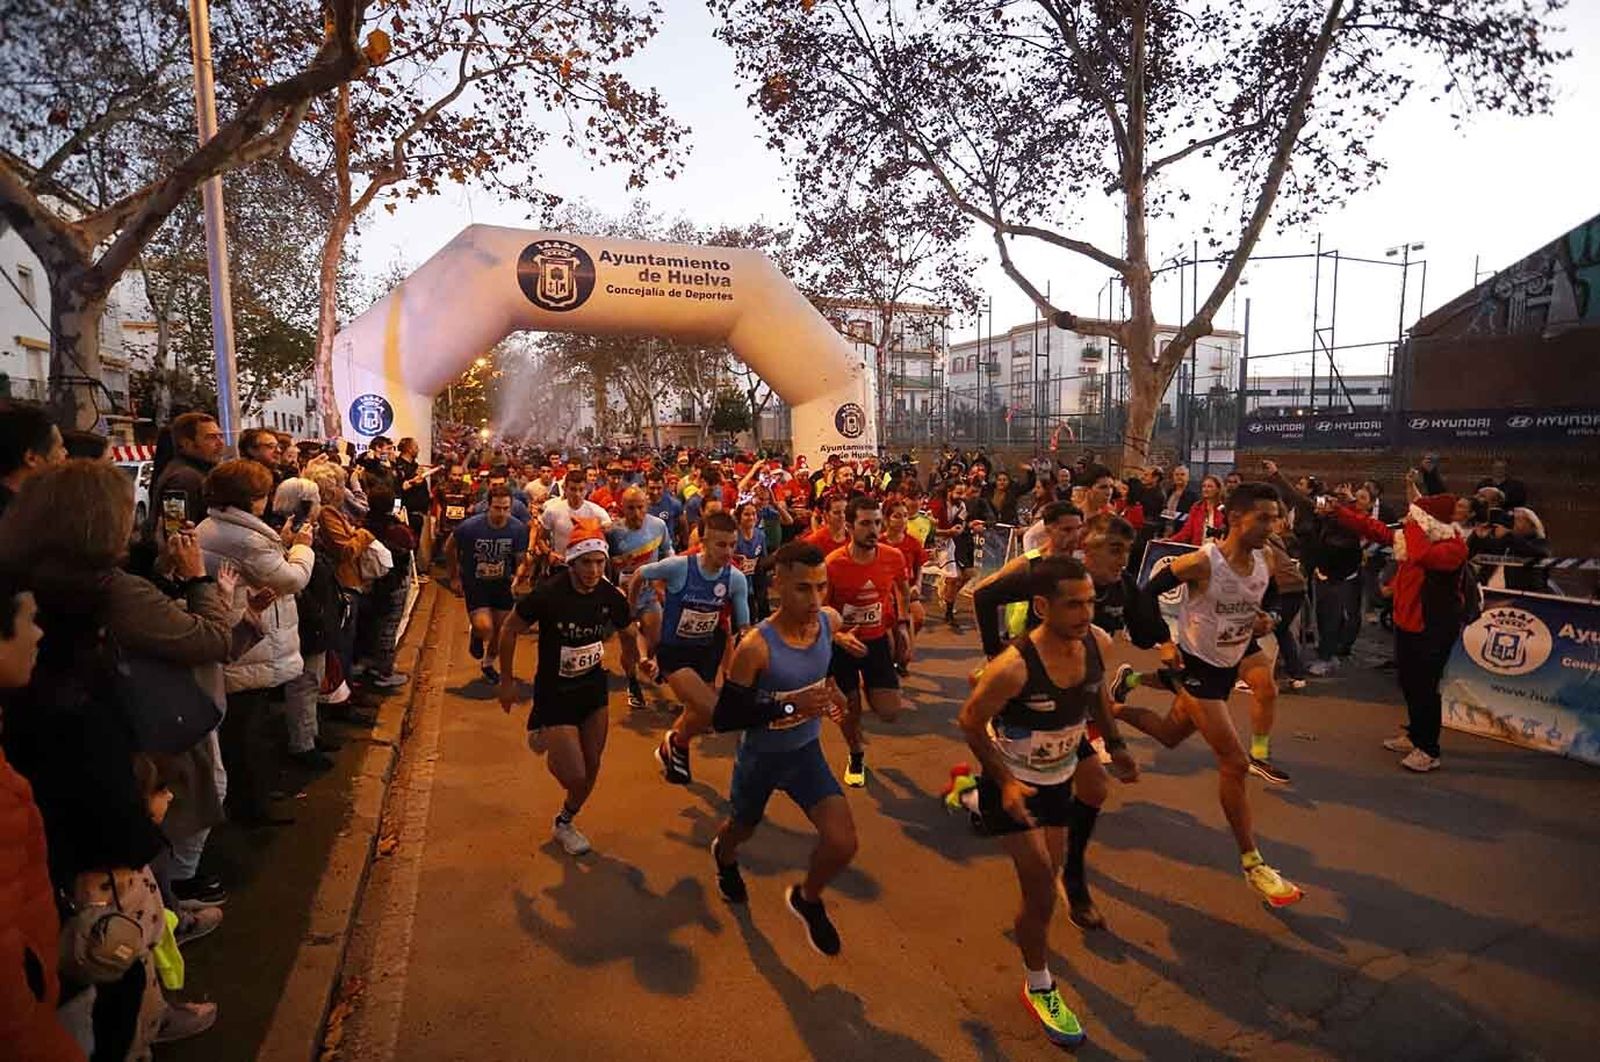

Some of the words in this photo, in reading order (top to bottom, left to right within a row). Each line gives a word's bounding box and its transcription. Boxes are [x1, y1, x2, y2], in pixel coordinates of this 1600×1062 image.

[599, 250, 730, 271] Ayuntamiento
[638, 268, 661, 282] de
[668, 270, 731, 287] Huelva
[606, 284, 665, 297] Concejalía
[668, 288, 682, 297] de
[685, 289, 733, 301] Deportes
[1265, 422, 1305, 432] HYUNDAI
[1334, 420, 1382, 430] HYUNDAI
[1431, 417, 1491, 428] HYUNDAI
